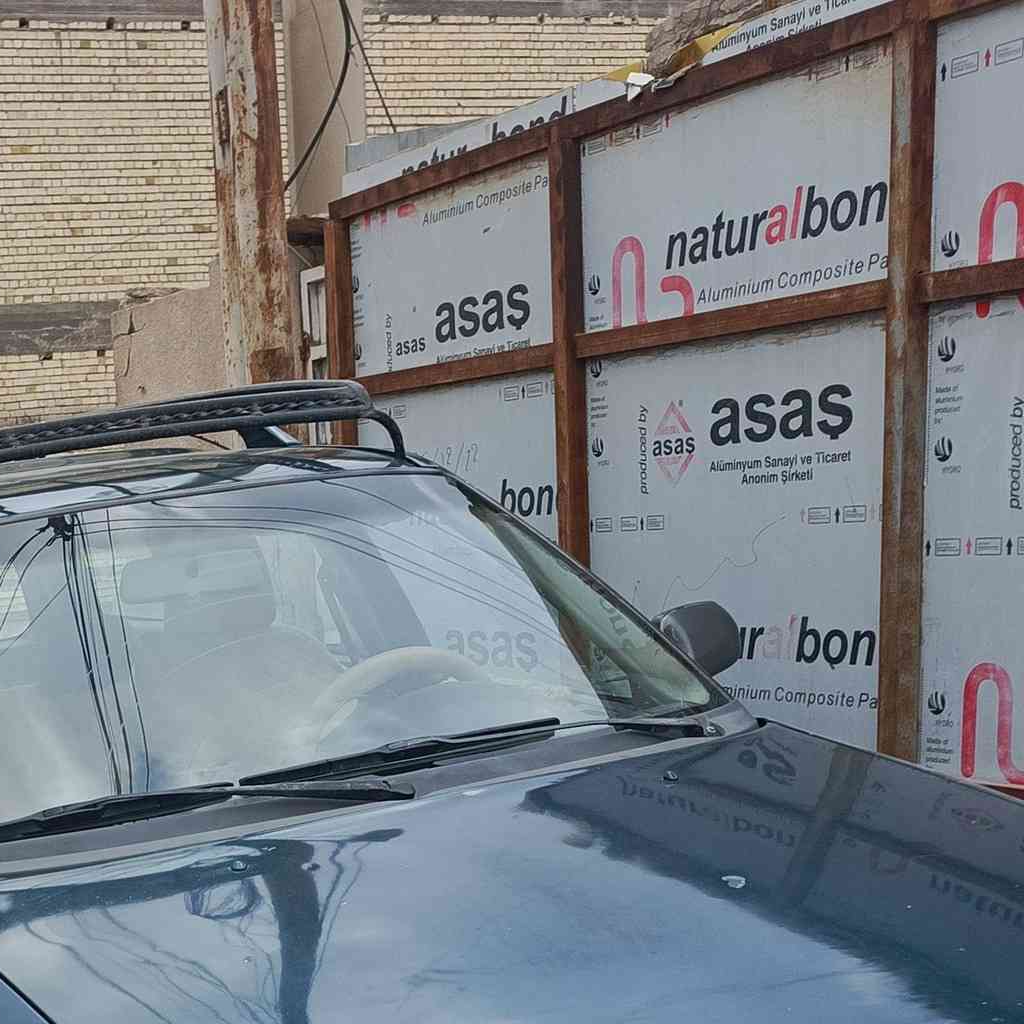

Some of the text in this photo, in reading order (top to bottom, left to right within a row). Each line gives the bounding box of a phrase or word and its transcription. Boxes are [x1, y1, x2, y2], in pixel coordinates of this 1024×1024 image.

[809, 4, 821, 17] ve
[423, 200, 474, 226] Aluminium
[476, 183, 532, 209] Composite
[697, 277, 774, 305] Aluminium
[777, 258, 863, 290] Composite
[435, 283, 531, 343] asaş
[710, 384, 854, 446] asaş
[638, 406, 649, 494] produced by
[764, 454, 798, 468] Sanayi
[800, 455, 812, 465] ve
[815, 450, 851, 464] Ticaret
[1008, 396, 1024, 510] produced by
[741, 471, 778, 485] Anonim
[775, 686, 854, 707] Composite
